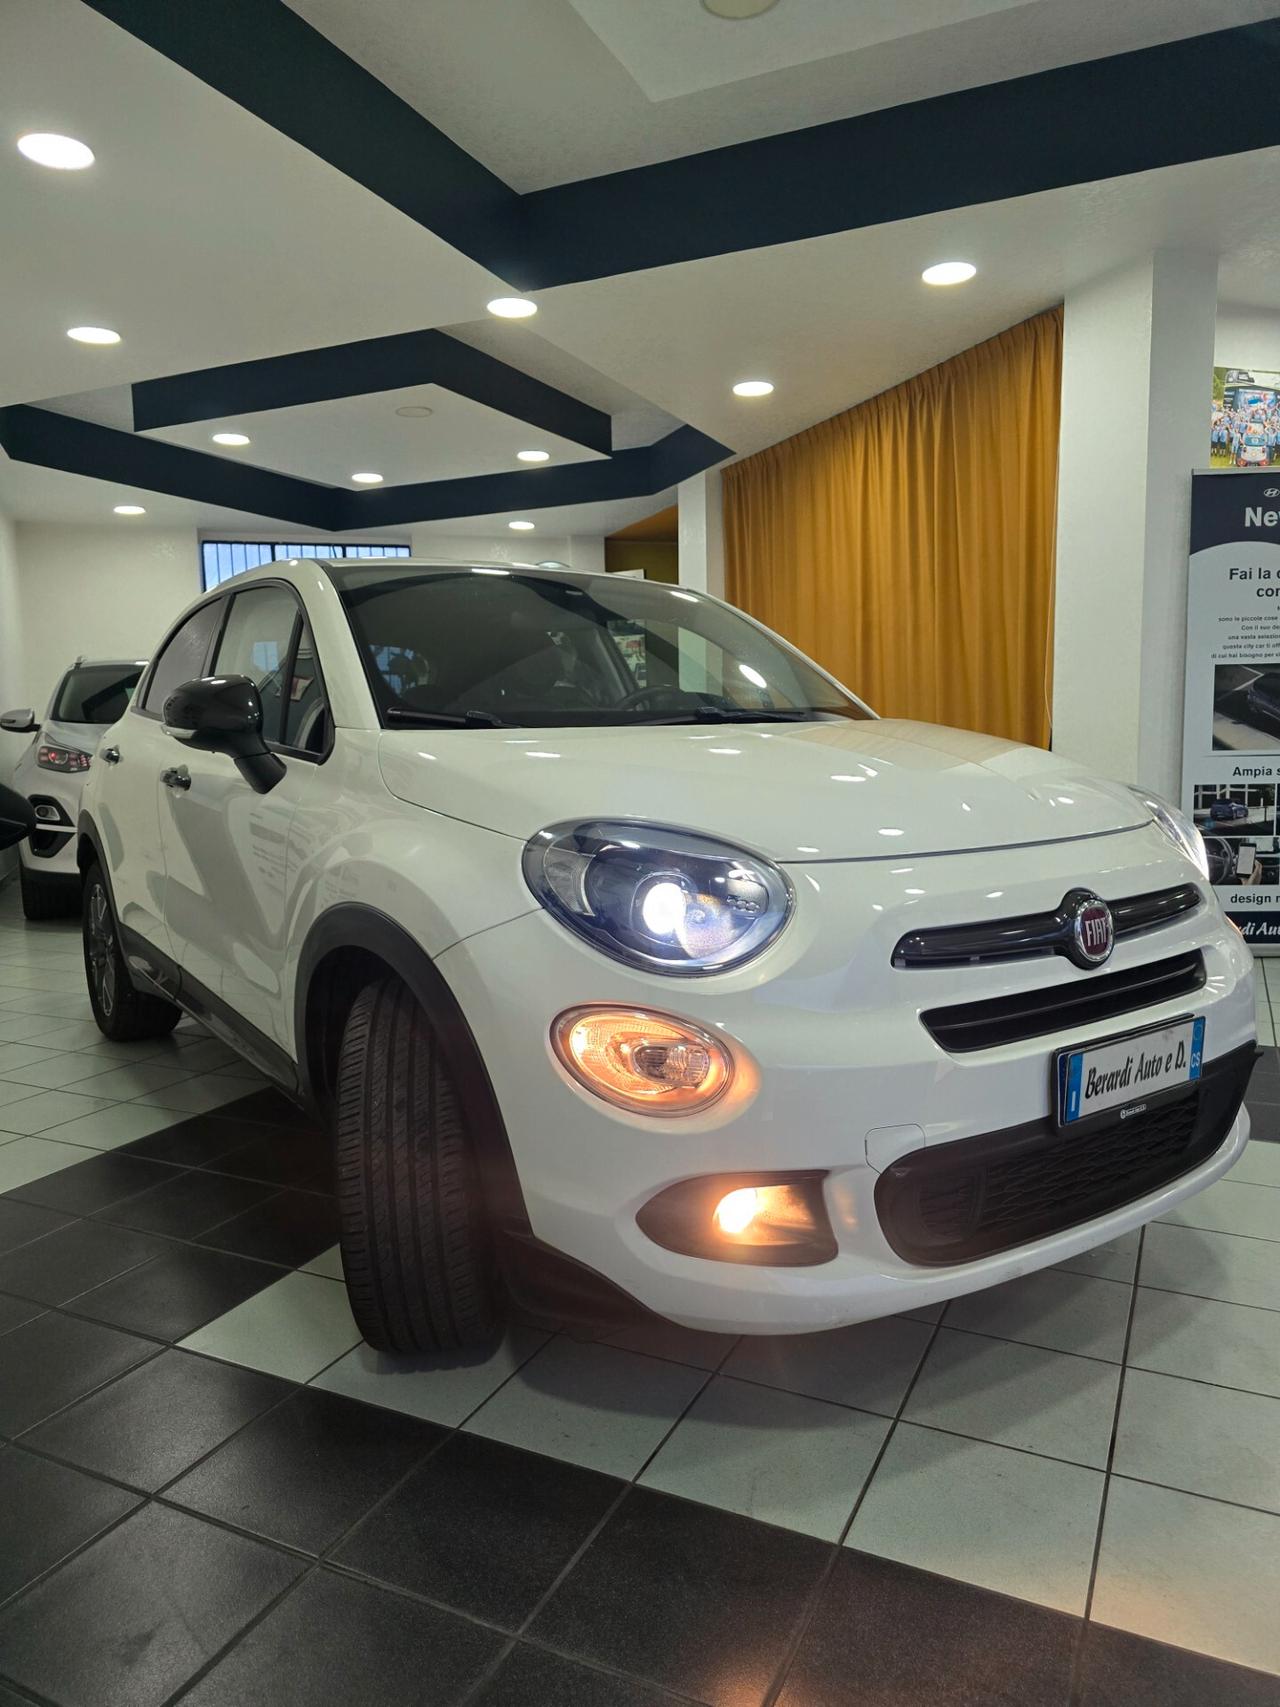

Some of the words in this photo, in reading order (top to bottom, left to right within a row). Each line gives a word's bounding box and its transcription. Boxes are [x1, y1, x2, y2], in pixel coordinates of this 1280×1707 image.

[1244, 507, 1280, 527] Ne
[1229, 567, 1252, 580] Fai
[1258, 567, 1271, 580] la
[1232, 766, 1272, 779] Ampia
[1230, 893, 1272, 906] design
[1085, 917, 1107, 947] FIAT
[1190, 1052, 1201, 1068] CS
[1085, 1056, 1134, 1100] Berardi
[1134, 1051, 1163, 1084] Auto
[1164, 1052, 1173, 1072] e
